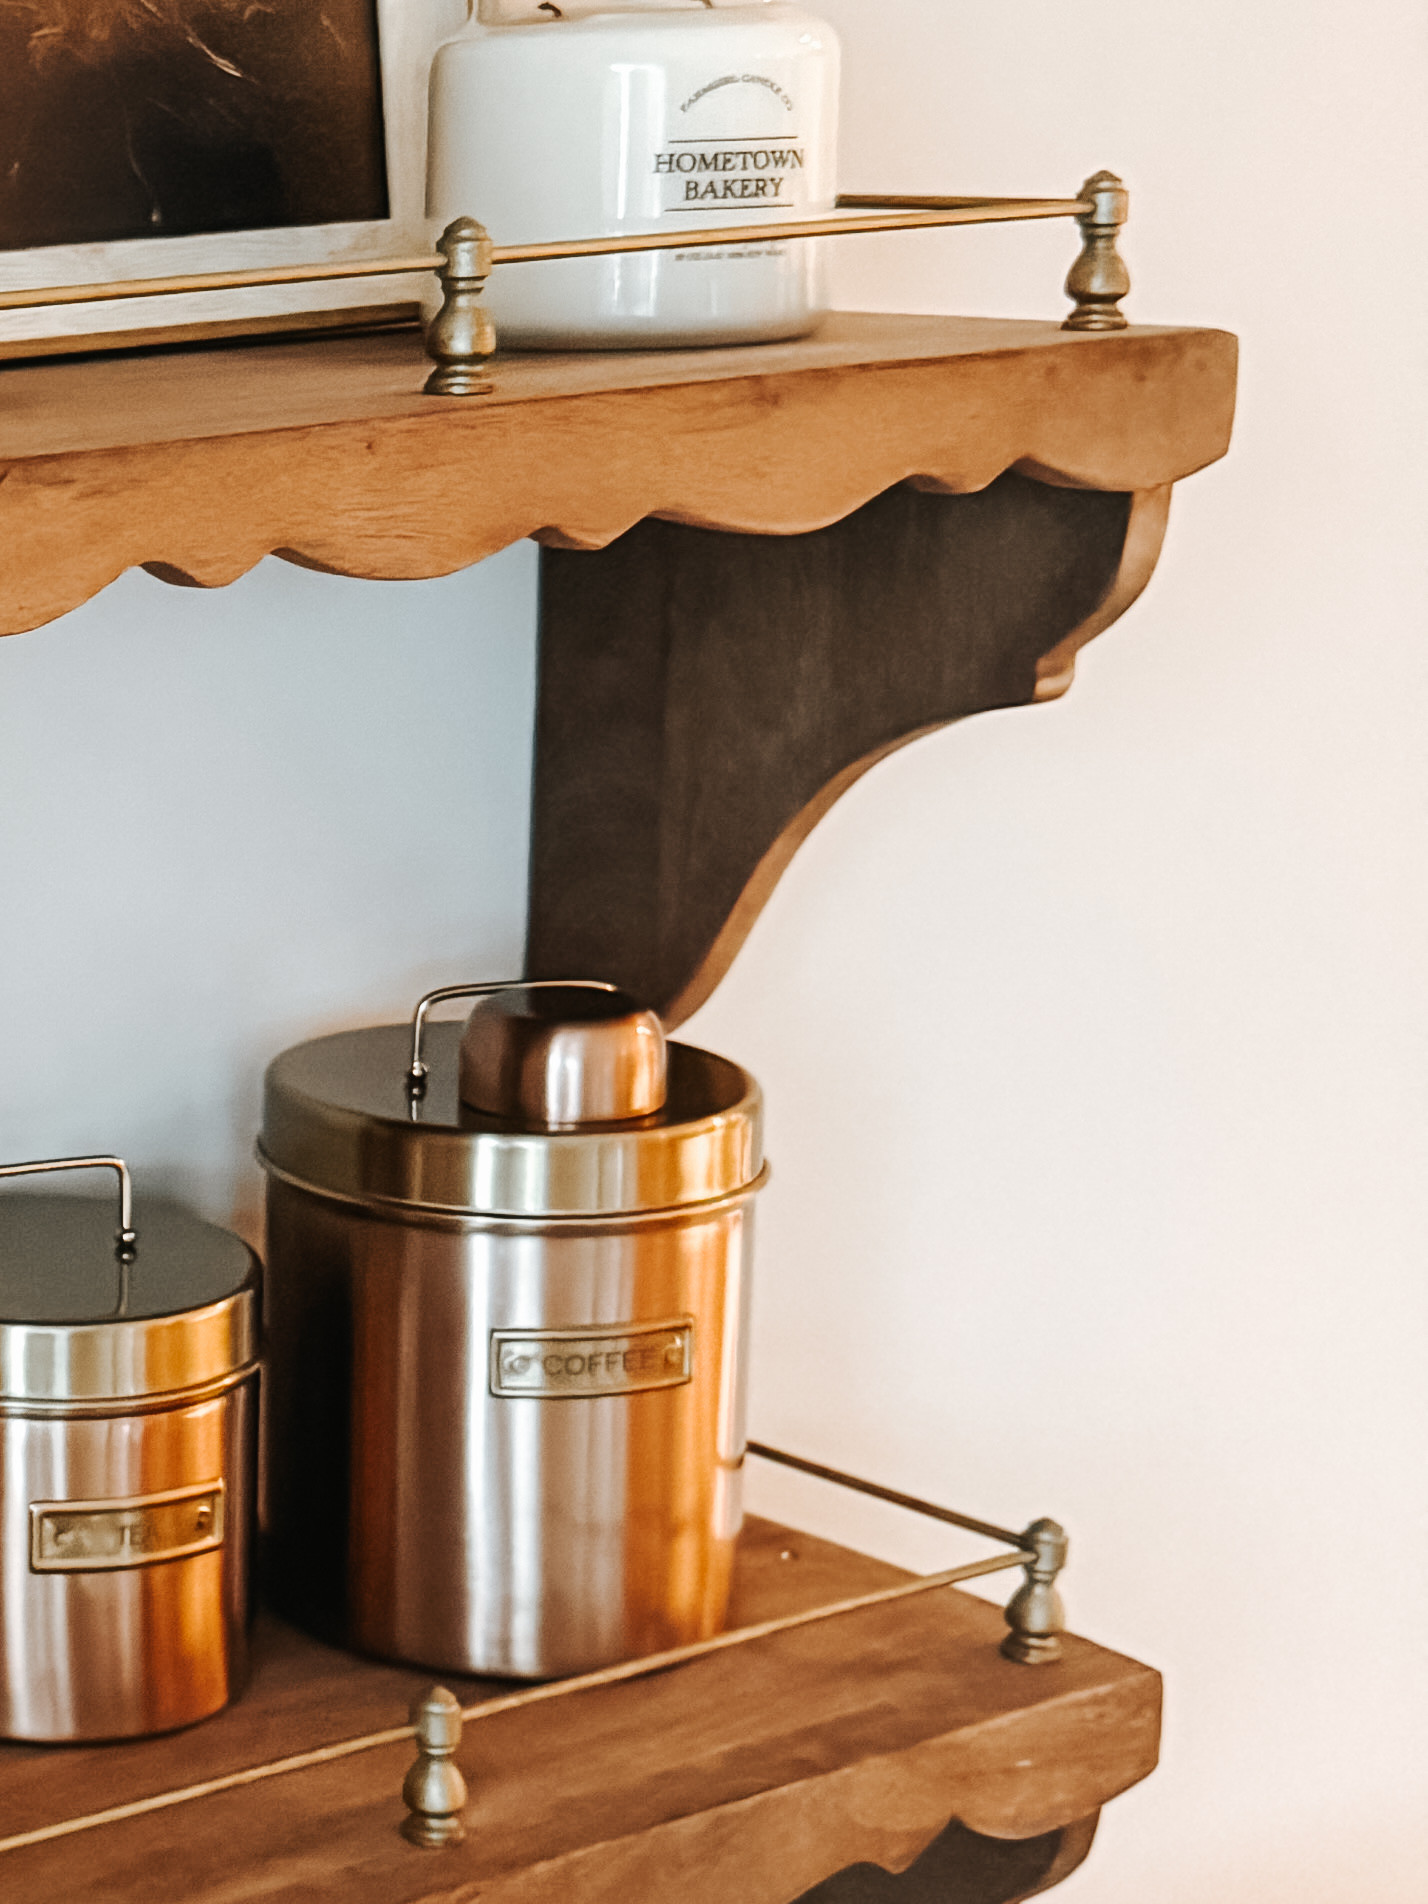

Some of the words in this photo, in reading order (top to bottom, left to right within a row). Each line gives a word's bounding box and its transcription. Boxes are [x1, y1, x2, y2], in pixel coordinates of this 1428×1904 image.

[653, 149, 805, 174] HOMETOWN
[685, 177, 784, 201] BAKERY
[543, 1349, 656, 1377] COFFEE
